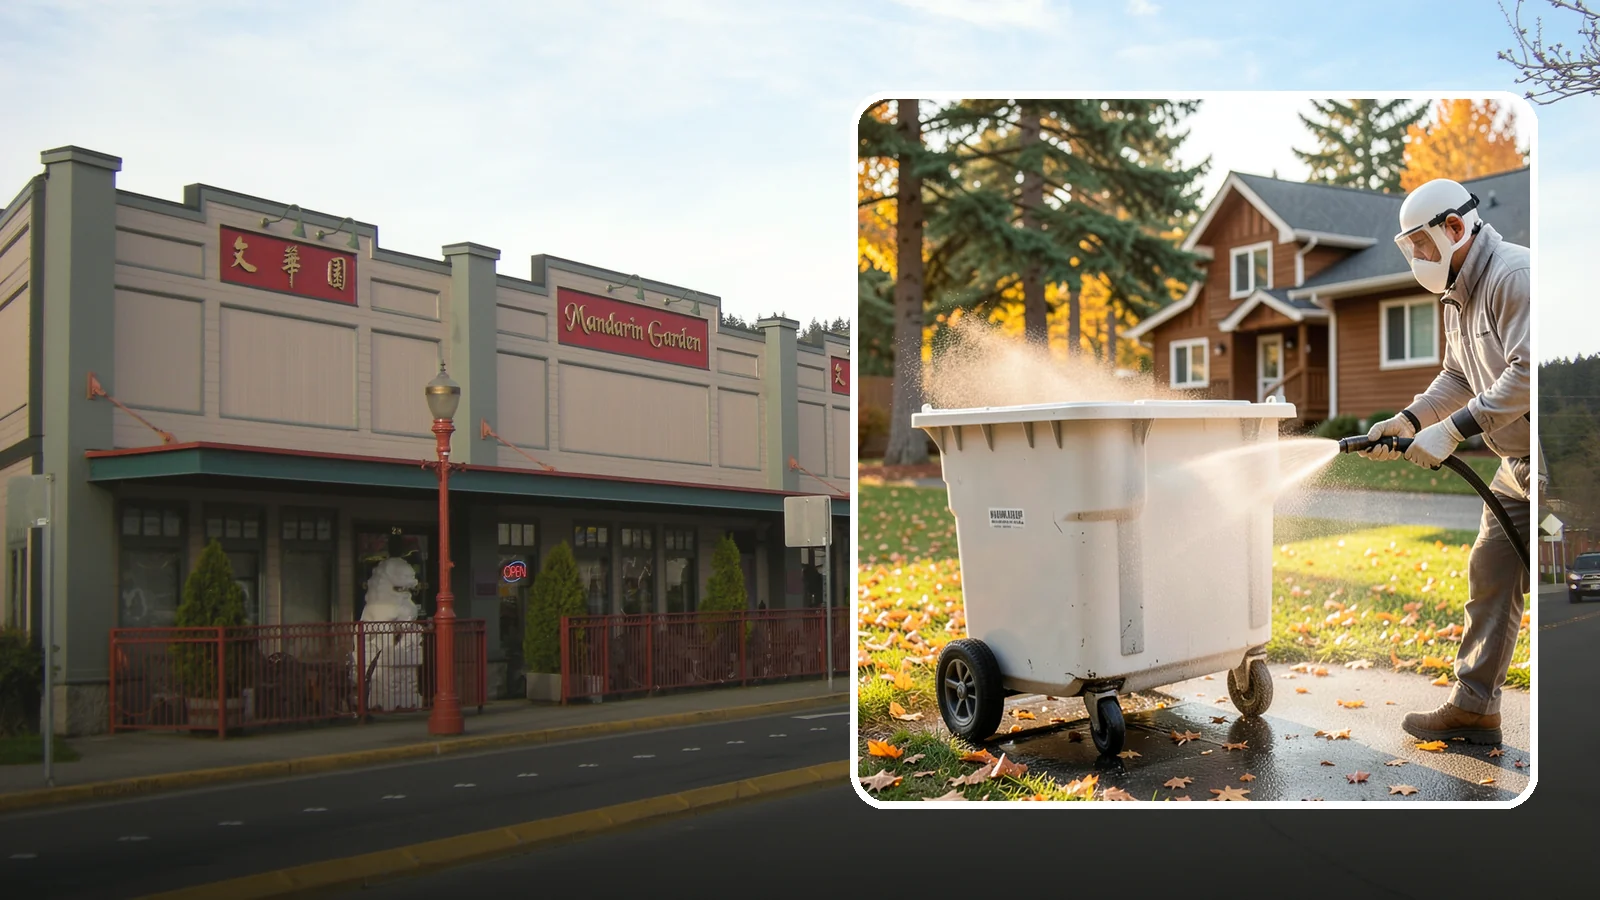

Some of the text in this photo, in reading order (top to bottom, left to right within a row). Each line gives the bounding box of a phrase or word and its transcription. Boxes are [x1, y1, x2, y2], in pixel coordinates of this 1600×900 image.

[231, 235, 346, 291] 文華園
[564, 302, 701, 352] Mandarin Garden
[503, 565, 527, 578] OPEN
